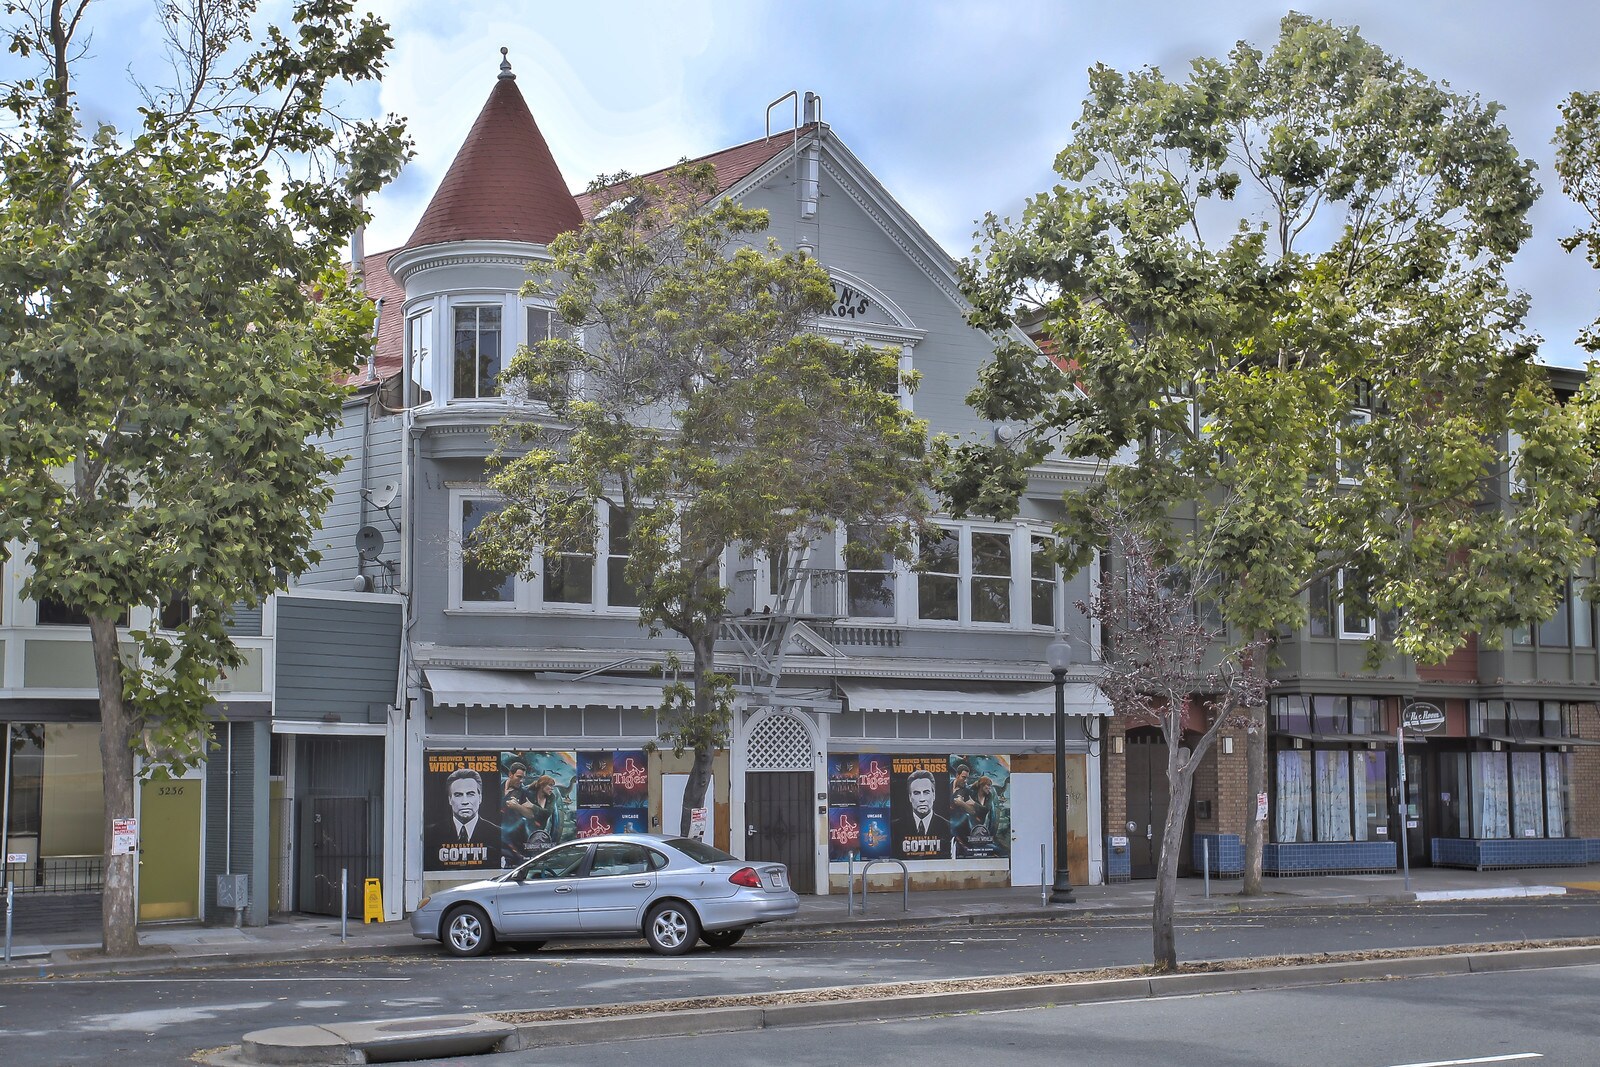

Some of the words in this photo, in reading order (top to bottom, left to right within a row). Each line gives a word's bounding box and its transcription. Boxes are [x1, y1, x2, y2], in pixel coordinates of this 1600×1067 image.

[429, 762, 465, 773] WHO'S
[892, 763, 922, 773] WHO'S
[612, 772, 648, 790] Tiger
[859, 774, 890, 790] Tiger
[159, 786, 185, 796] 3236
[829, 827, 860, 845] Tiger
[902, 839, 941, 853] GOTTI
[438, 847, 488, 862] GOTTI
